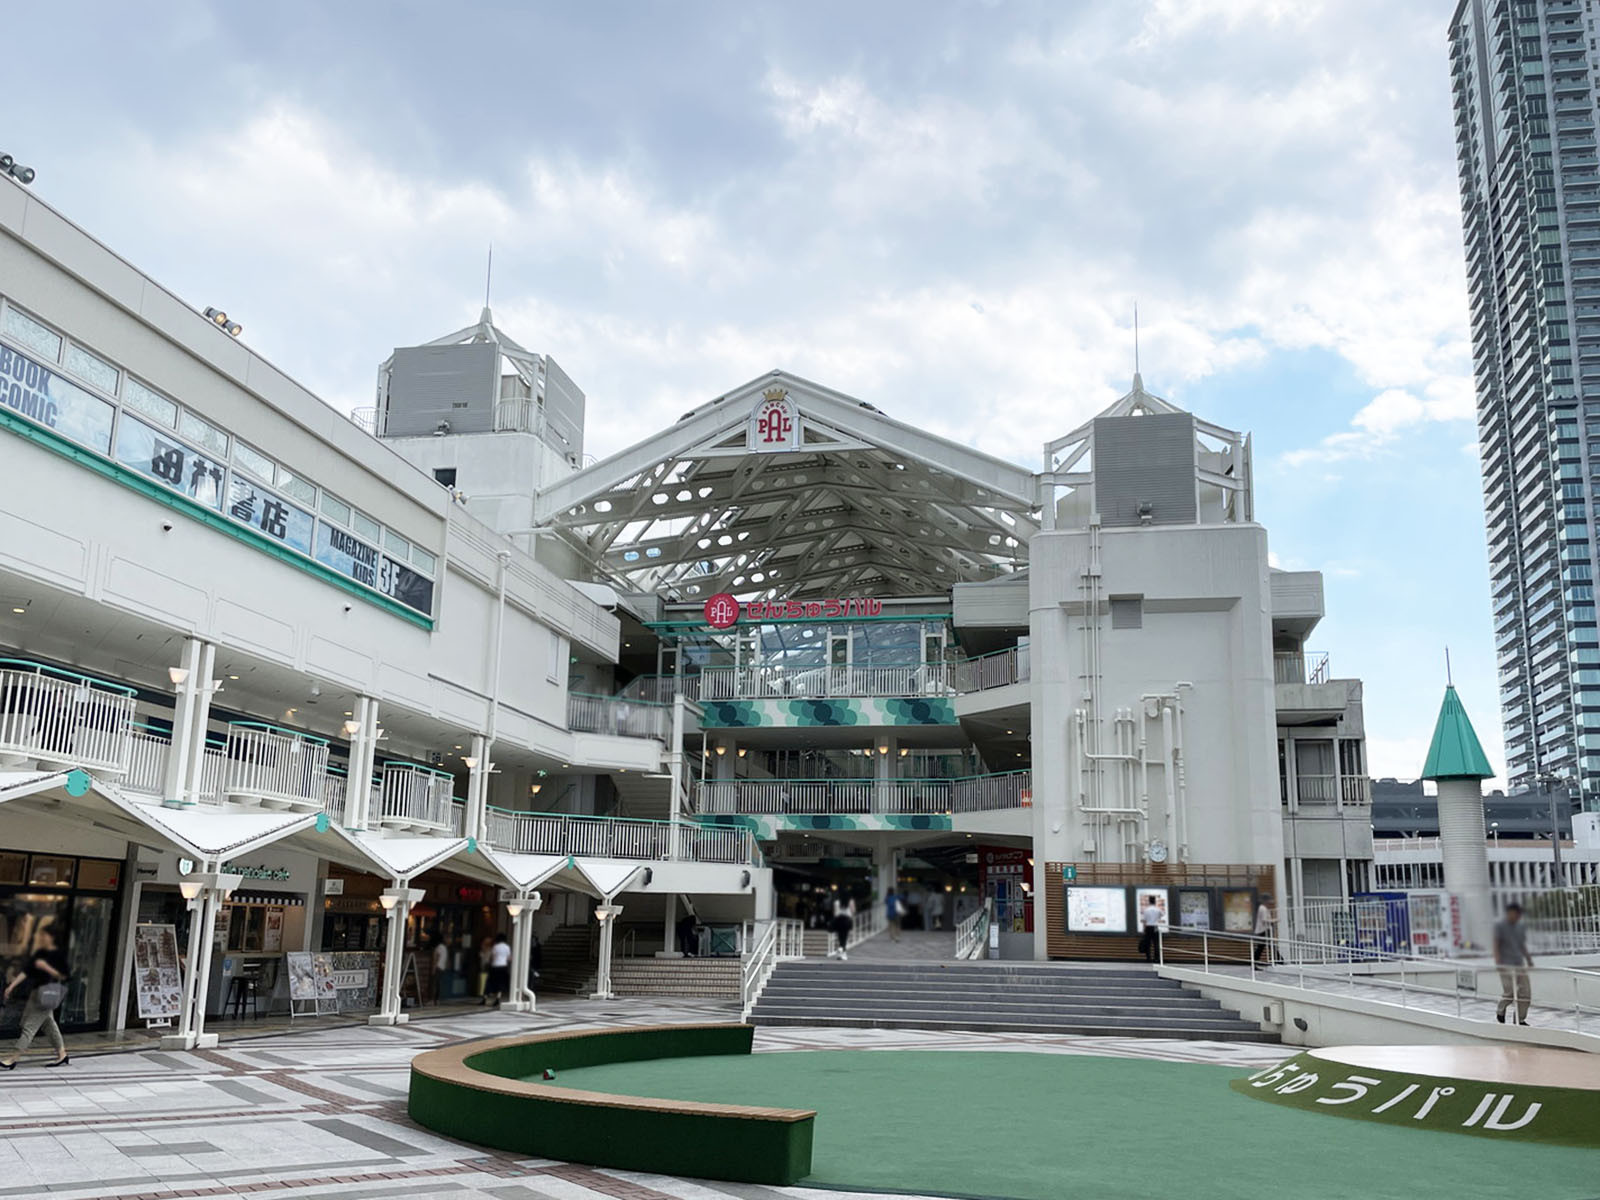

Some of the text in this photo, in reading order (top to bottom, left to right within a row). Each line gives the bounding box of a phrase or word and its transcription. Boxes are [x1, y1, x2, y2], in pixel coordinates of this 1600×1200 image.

[0, 345, 51, 396] BOOK
[0, 376, 57, 428] COMIC
[758, 409, 792, 442] PAL
[330, 528, 377, 568] MAGAZINE
[352, 561, 375, 587] KIDS
[380, 557, 400, 596] 3F
[710, 601, 733, 624] PAL
